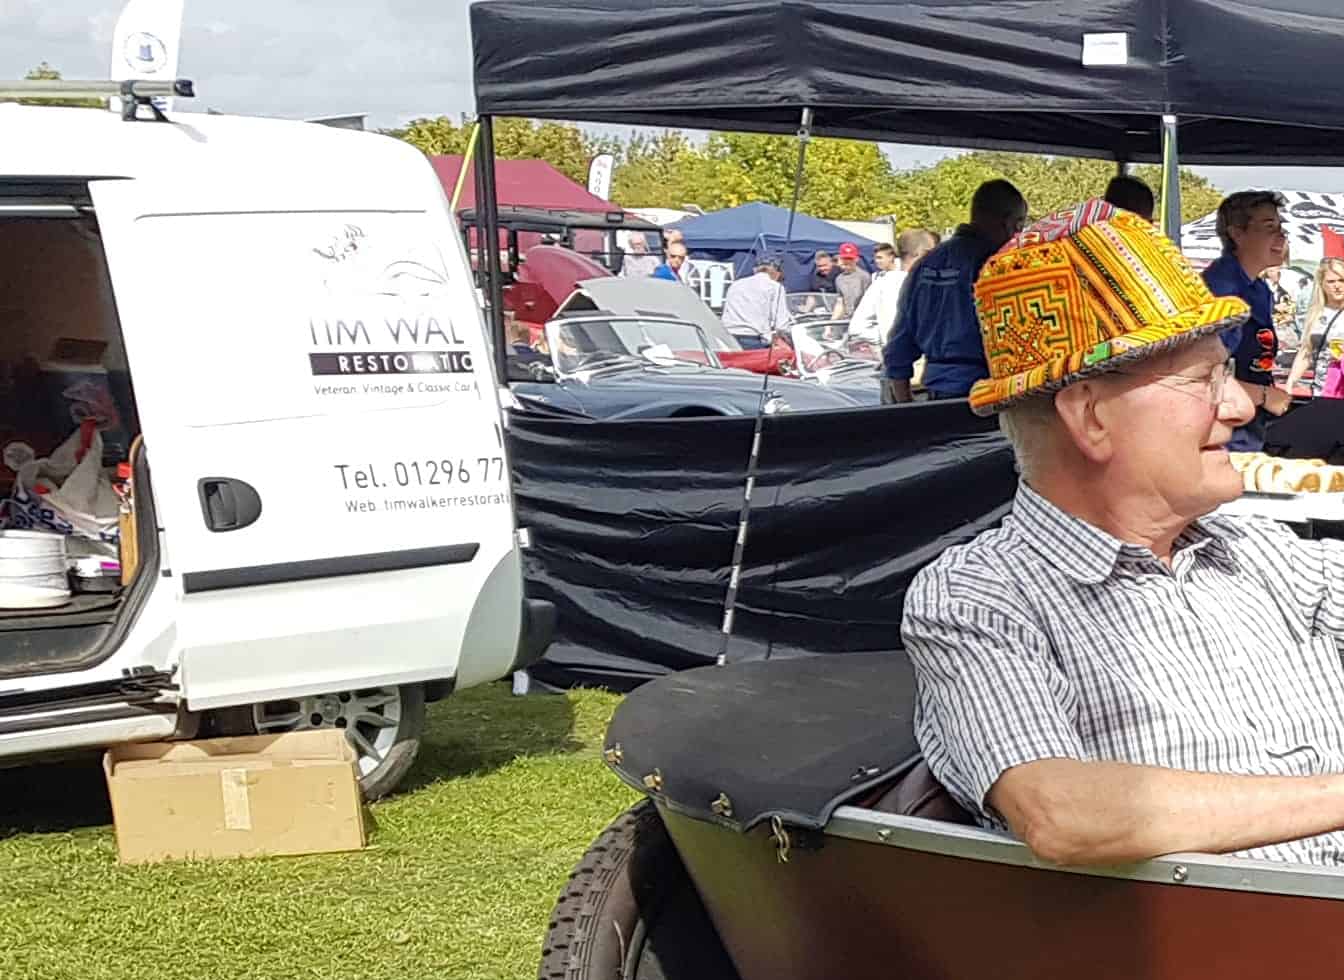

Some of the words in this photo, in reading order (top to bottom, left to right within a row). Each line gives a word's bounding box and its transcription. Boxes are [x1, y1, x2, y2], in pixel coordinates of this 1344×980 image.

[338, 354, 473, 373] RESTOTIO
[333, 463, 387, 489] Tel.
[393, 458, 470, 487] 01296
